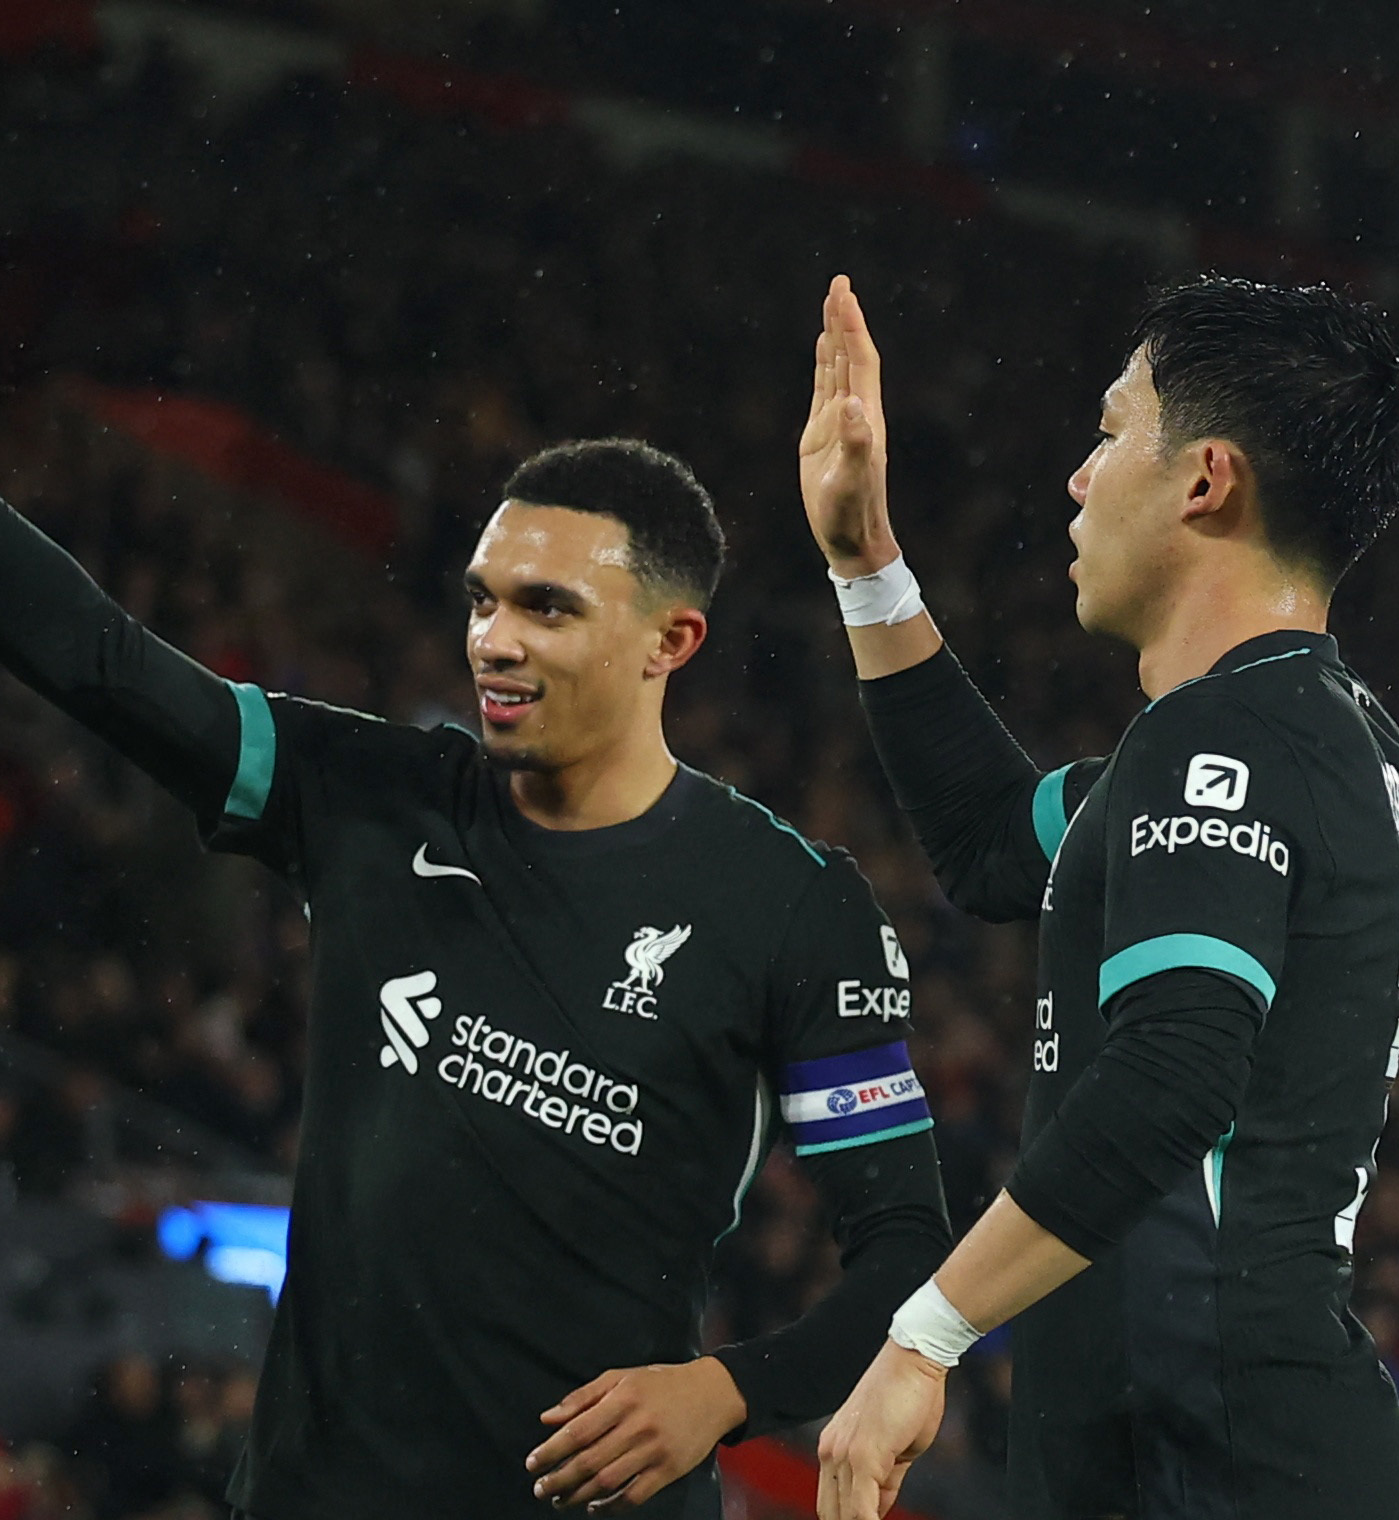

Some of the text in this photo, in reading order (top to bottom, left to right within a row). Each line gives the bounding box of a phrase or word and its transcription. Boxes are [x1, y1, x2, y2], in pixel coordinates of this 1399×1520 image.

[1131, 813, 1290, 878] Expedia
[437, 1052, 645, 1157] chartered
[451, 1014, 641, 1115] standard
[858, 1085, 890, 1104] EFL
